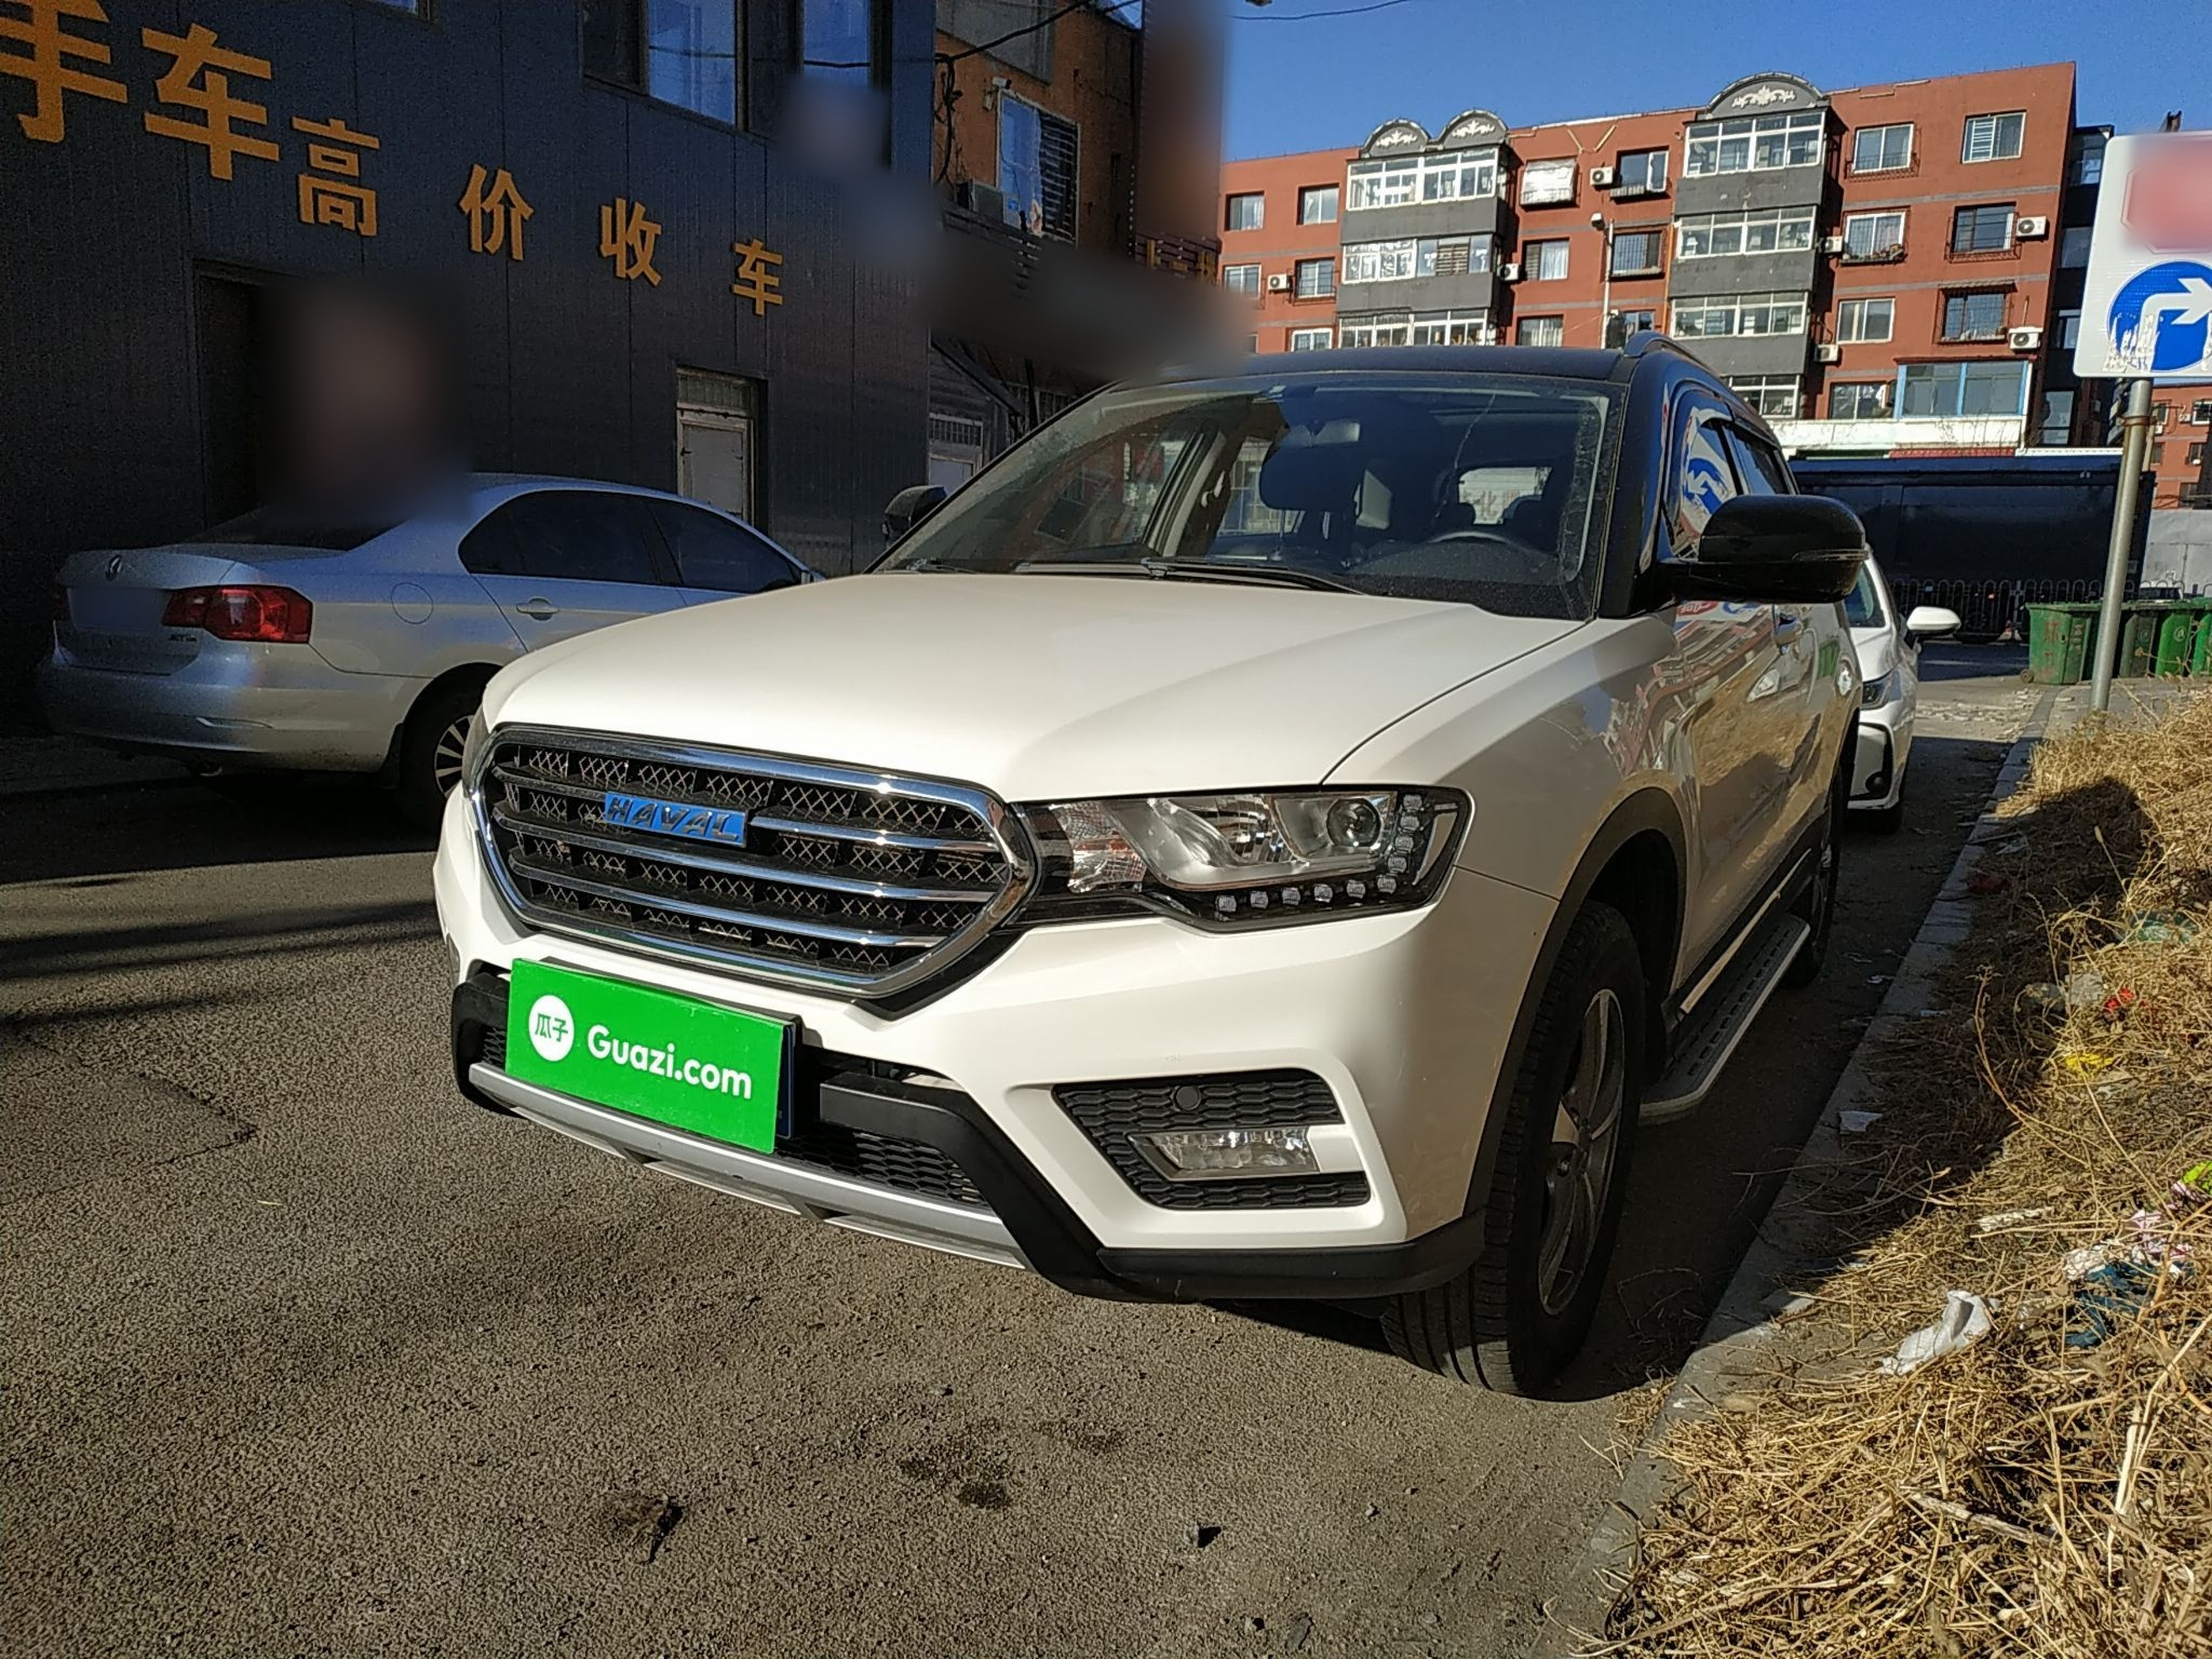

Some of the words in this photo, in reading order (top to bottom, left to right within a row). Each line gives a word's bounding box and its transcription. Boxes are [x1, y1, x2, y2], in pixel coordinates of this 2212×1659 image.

[607, 796, 739, 841] HAVAL
[535, 1013, 569, 1041] 瓜子
[588, 1025, 752, 1099] Guazi.com
